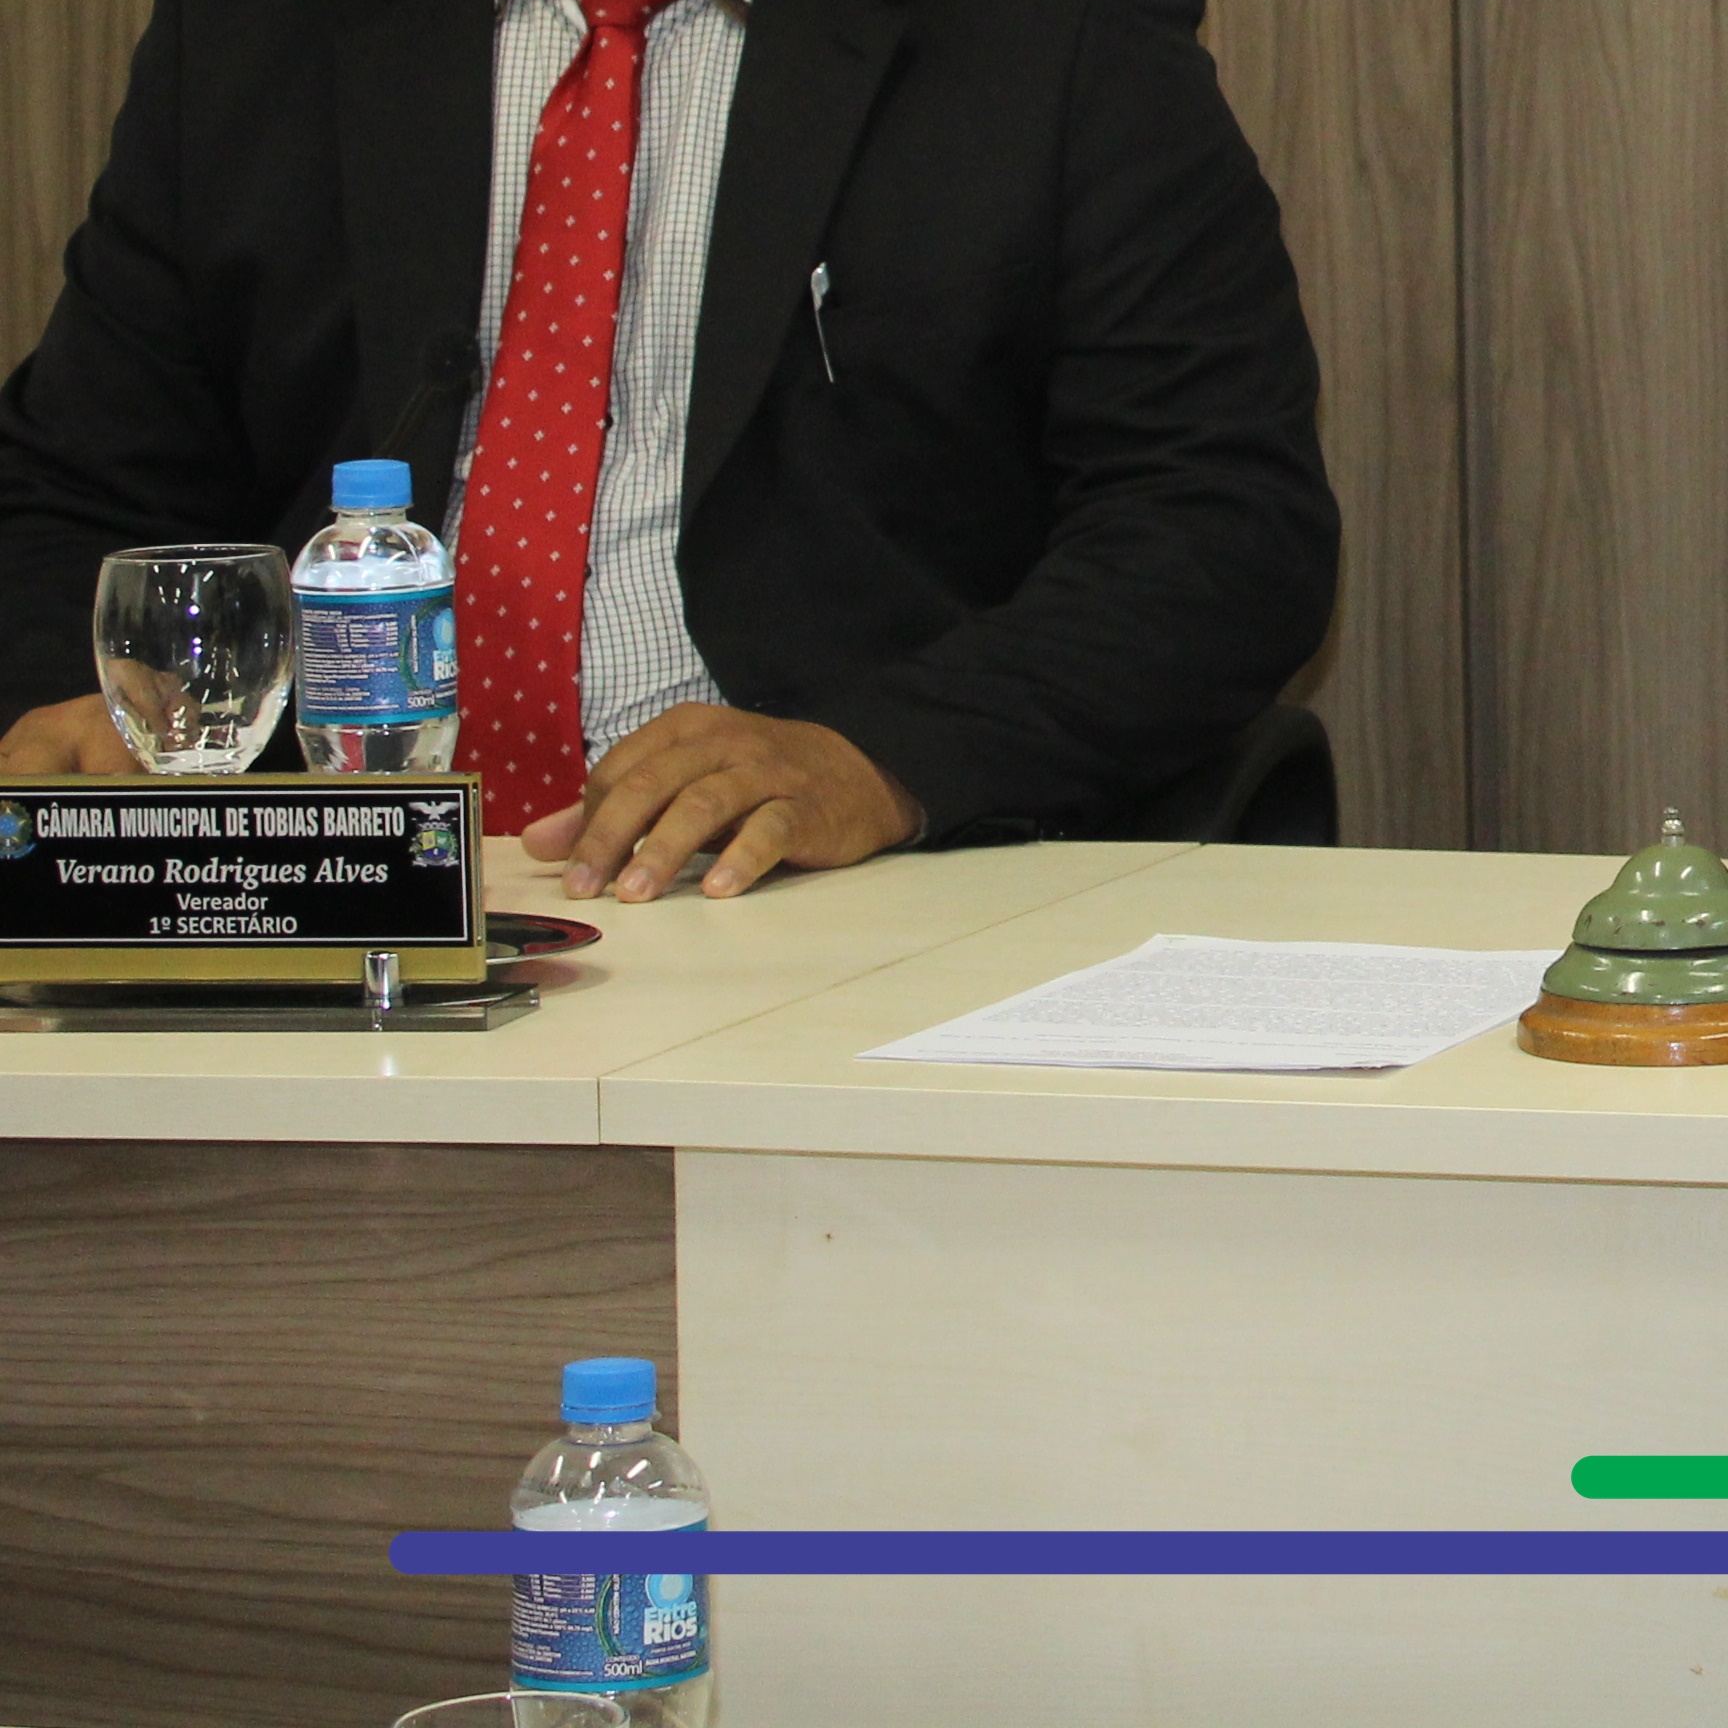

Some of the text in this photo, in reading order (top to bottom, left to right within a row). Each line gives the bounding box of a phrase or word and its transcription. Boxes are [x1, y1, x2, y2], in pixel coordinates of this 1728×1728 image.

[36, 801, 406, 839] CÂMARA MUNICIPAL DE TOBIAS BARRETO
[56, 858, 389, 890] Verano Rodrigues Alves
[176, 892, 269, 912] Vereador
[176, 912, 298, 936] SECRETÁRIO
[644, 1601, 698, 1622] Entre
[604, 1660, 643, 1677] 500ml
